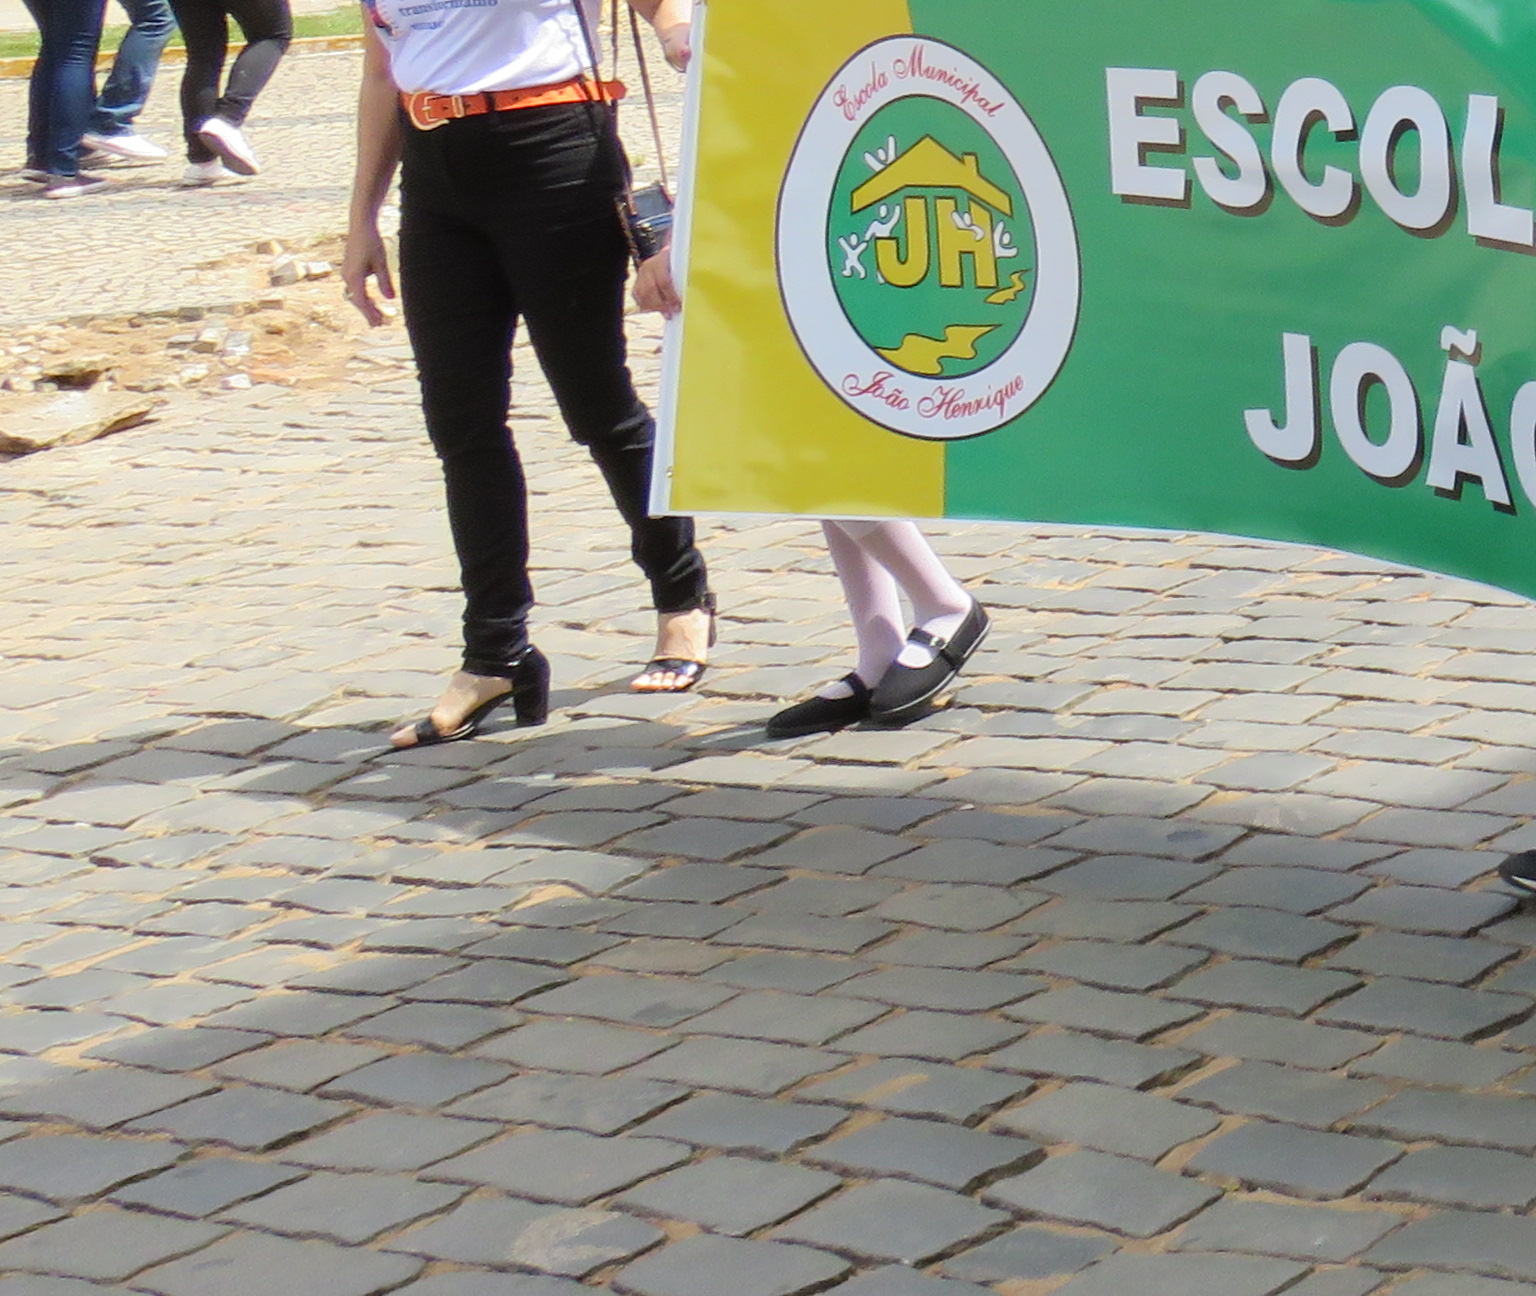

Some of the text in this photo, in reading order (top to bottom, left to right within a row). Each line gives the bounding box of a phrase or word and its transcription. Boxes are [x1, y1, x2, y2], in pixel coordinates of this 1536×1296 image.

[833, 43, 1006, 121] Escola Municipal
[874, 195, 998, 288] JH
[841, 371, 1024, 421] João Henrique
